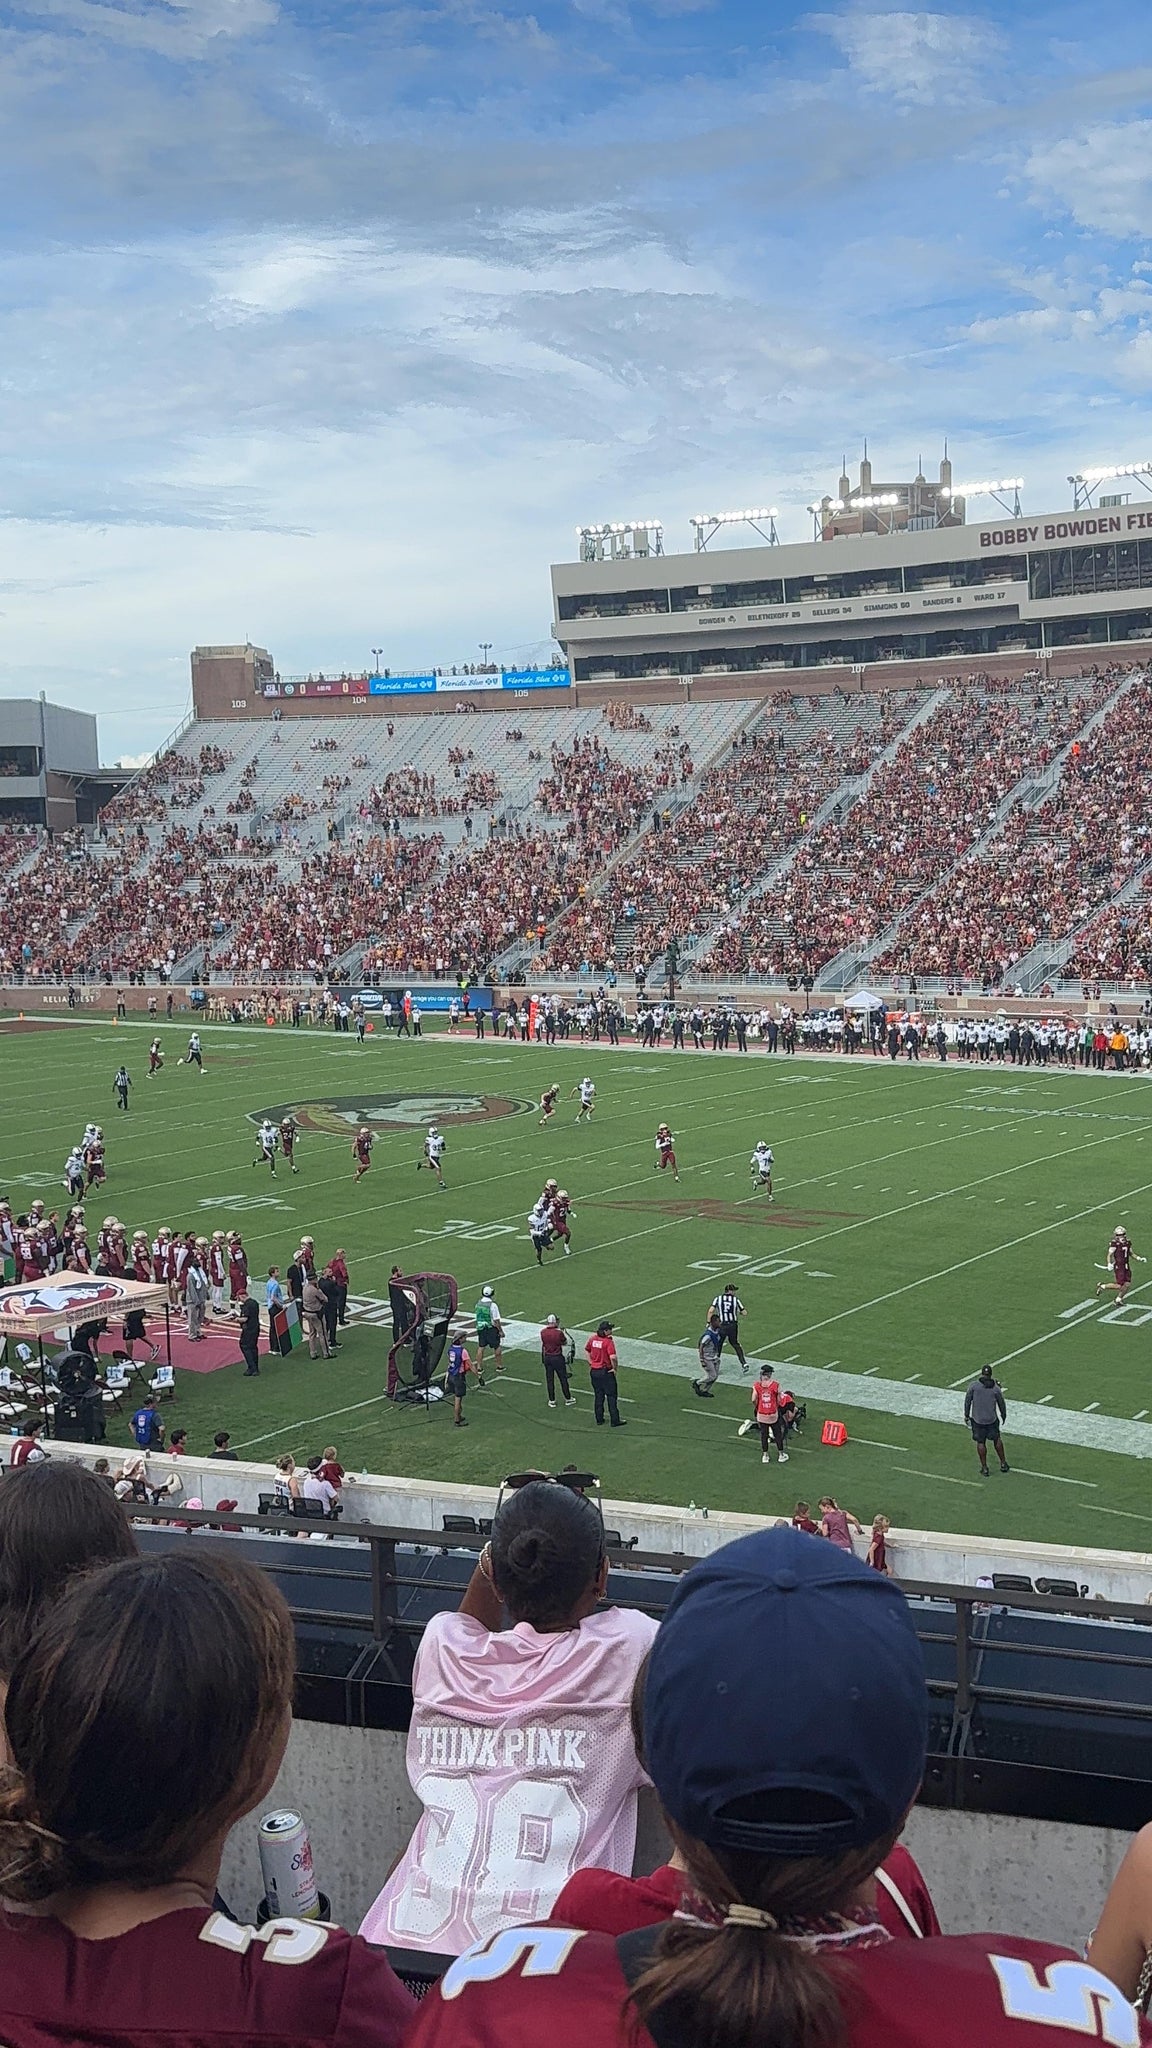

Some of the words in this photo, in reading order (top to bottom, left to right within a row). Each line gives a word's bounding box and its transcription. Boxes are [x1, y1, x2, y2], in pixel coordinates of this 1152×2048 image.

[980, 526, 1038, 547] BOBBY
[1044, 516, 1120, 540] BOWDEN
[923, 598, 954, 607] SANDERS
[974, 594, 995, 602] WARD
[864, 604, 898, 612] SIMMONS
[375, 683, 401, 691] Florida
[468, 678, 484, 686] Blue
[514, 690, 529, 698] 105
[232, 700, 246, 708] 103
[43, 995, 95, 1003] RELIAUEST
[414, 1220, 520, 1240] 30
[1122, 1246, 1128, 1257] 7
[686, 1253, 805, 1277] 20
[723, 1301, 732, 1313] F
[826, 1424, 840, 1441] 10
[416, 1726, 498, 1767] THINK
[440, 1927, 588, 2001] 5
[987, 1953, 1141, 2048] 5
